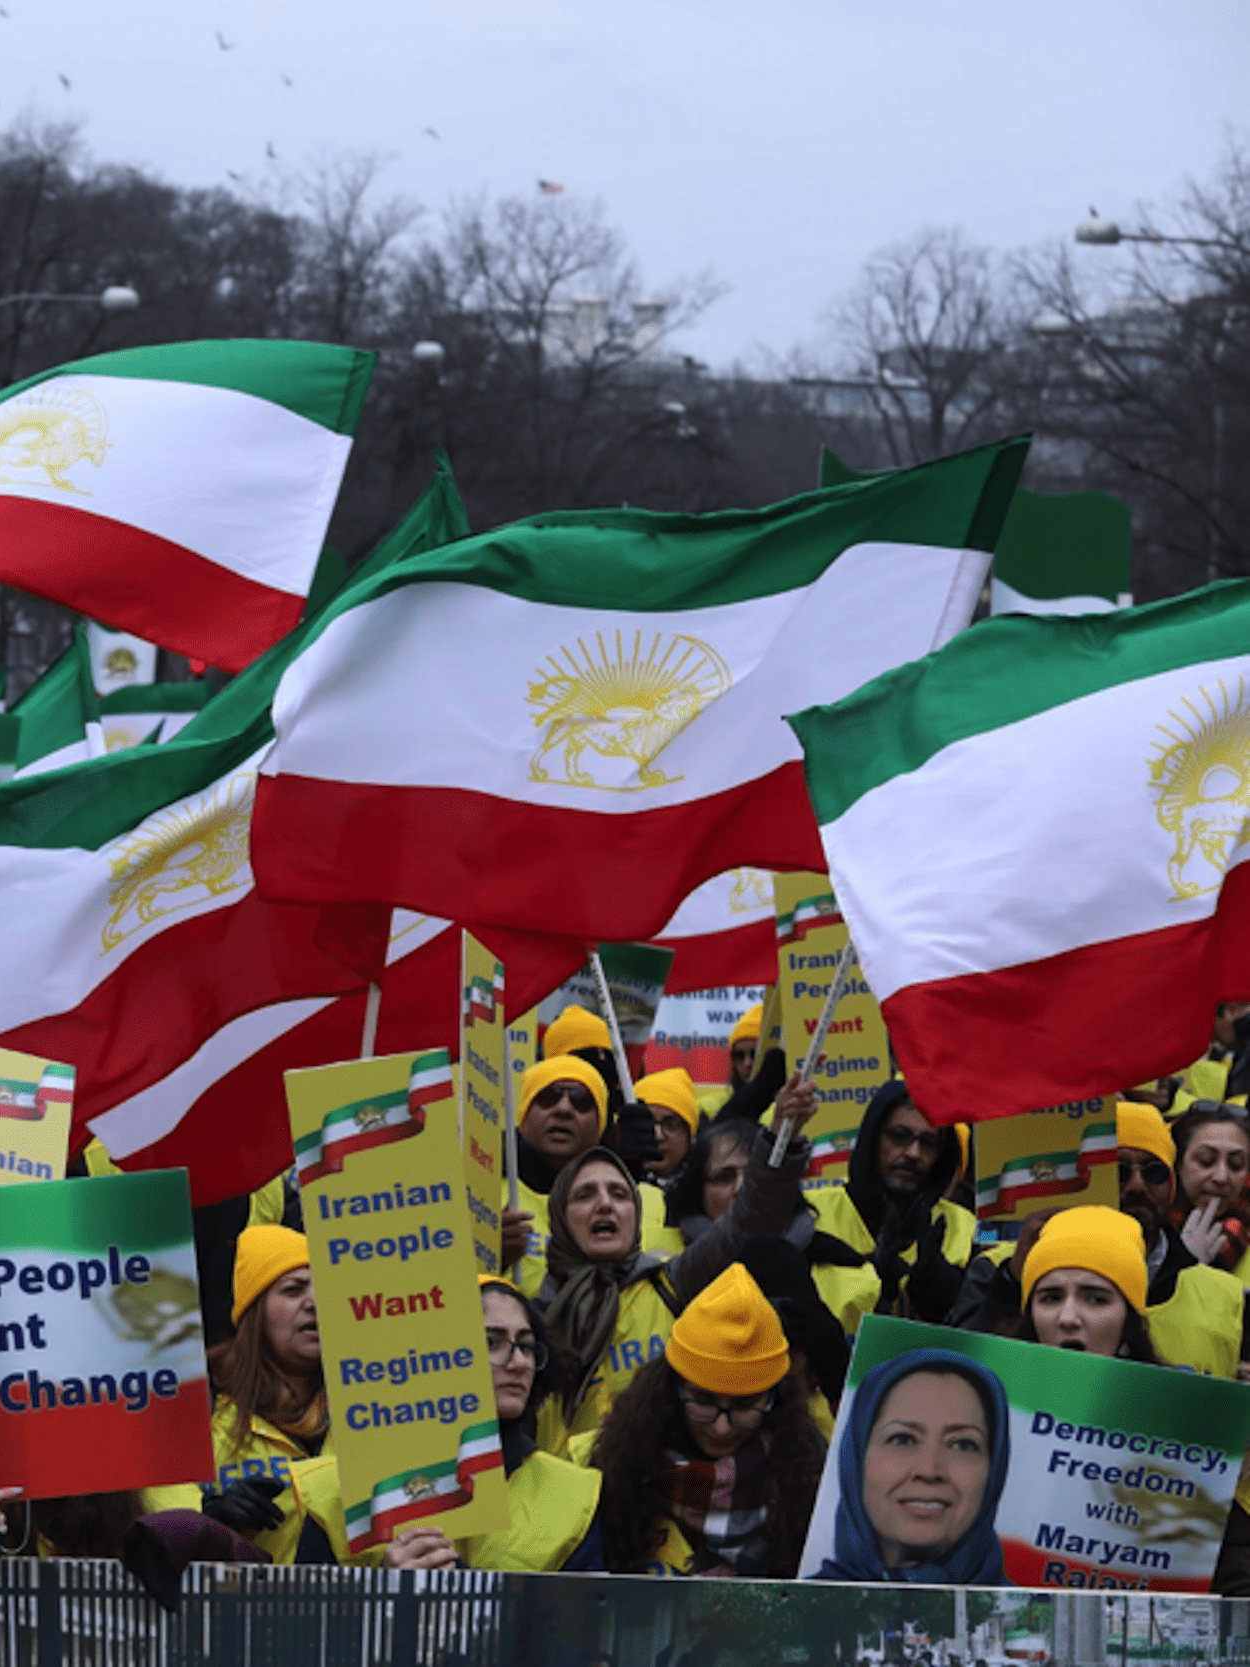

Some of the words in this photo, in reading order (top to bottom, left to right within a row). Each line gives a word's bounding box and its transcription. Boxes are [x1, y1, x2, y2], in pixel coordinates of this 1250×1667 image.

[317, 1180, 452, 1221] Iranian
[328, 1225, 455, 1266] People
[347, 1284, 447, 1322] Want
[338, 1344, 475, 1387] Regime
[345, 1392, 480, 1431] Change
[1030, 1411, 1230, 1476] Democracy,
[1047, 1450, 1197, 1499] Freedom
[1084, 1500, 1140, 1527] with
[1034, 1523, 1172, 1570] Maryam
